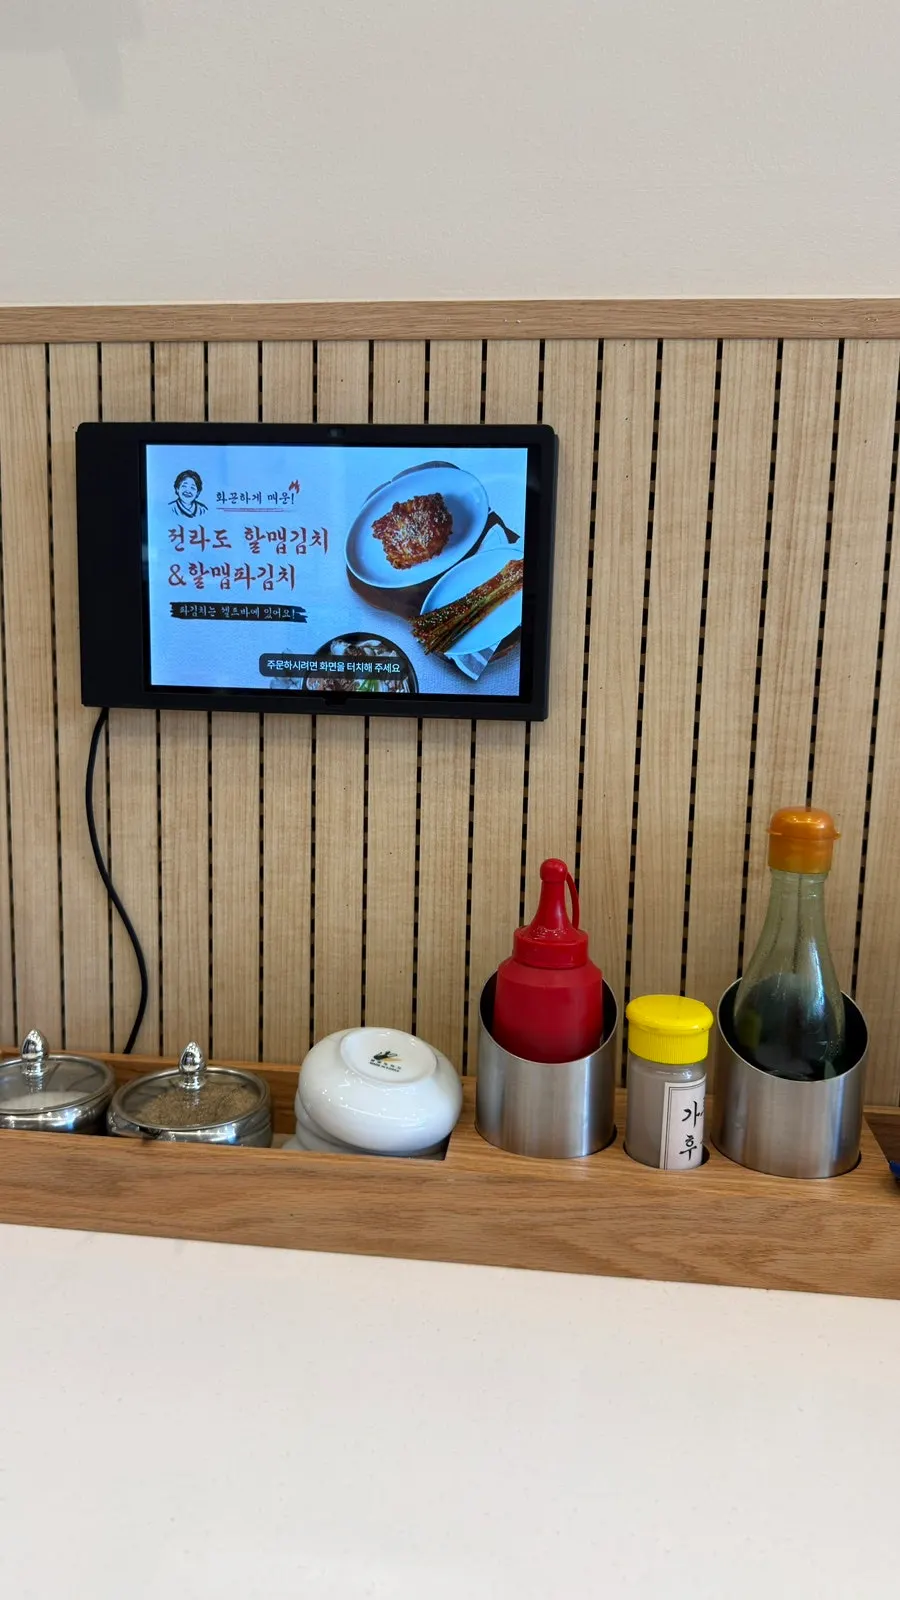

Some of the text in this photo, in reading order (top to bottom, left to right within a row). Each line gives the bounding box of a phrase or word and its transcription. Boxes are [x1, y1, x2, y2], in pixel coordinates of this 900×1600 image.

[216, 490, 295, 505] 화끈하게 매운!
[168, 524, 329, 555] 전라도 할맵김치
[168, 560, 296, 591] &할맵파김치
[179, 605, 296, 619] 파김치는 셀프바에 있어요!
[267, 659, 401, 674] 주문하시려면 화면을 터치해 주세요
[681, 1100, 703, 1128] 가
[678, 1133, 701, 1161] 후
